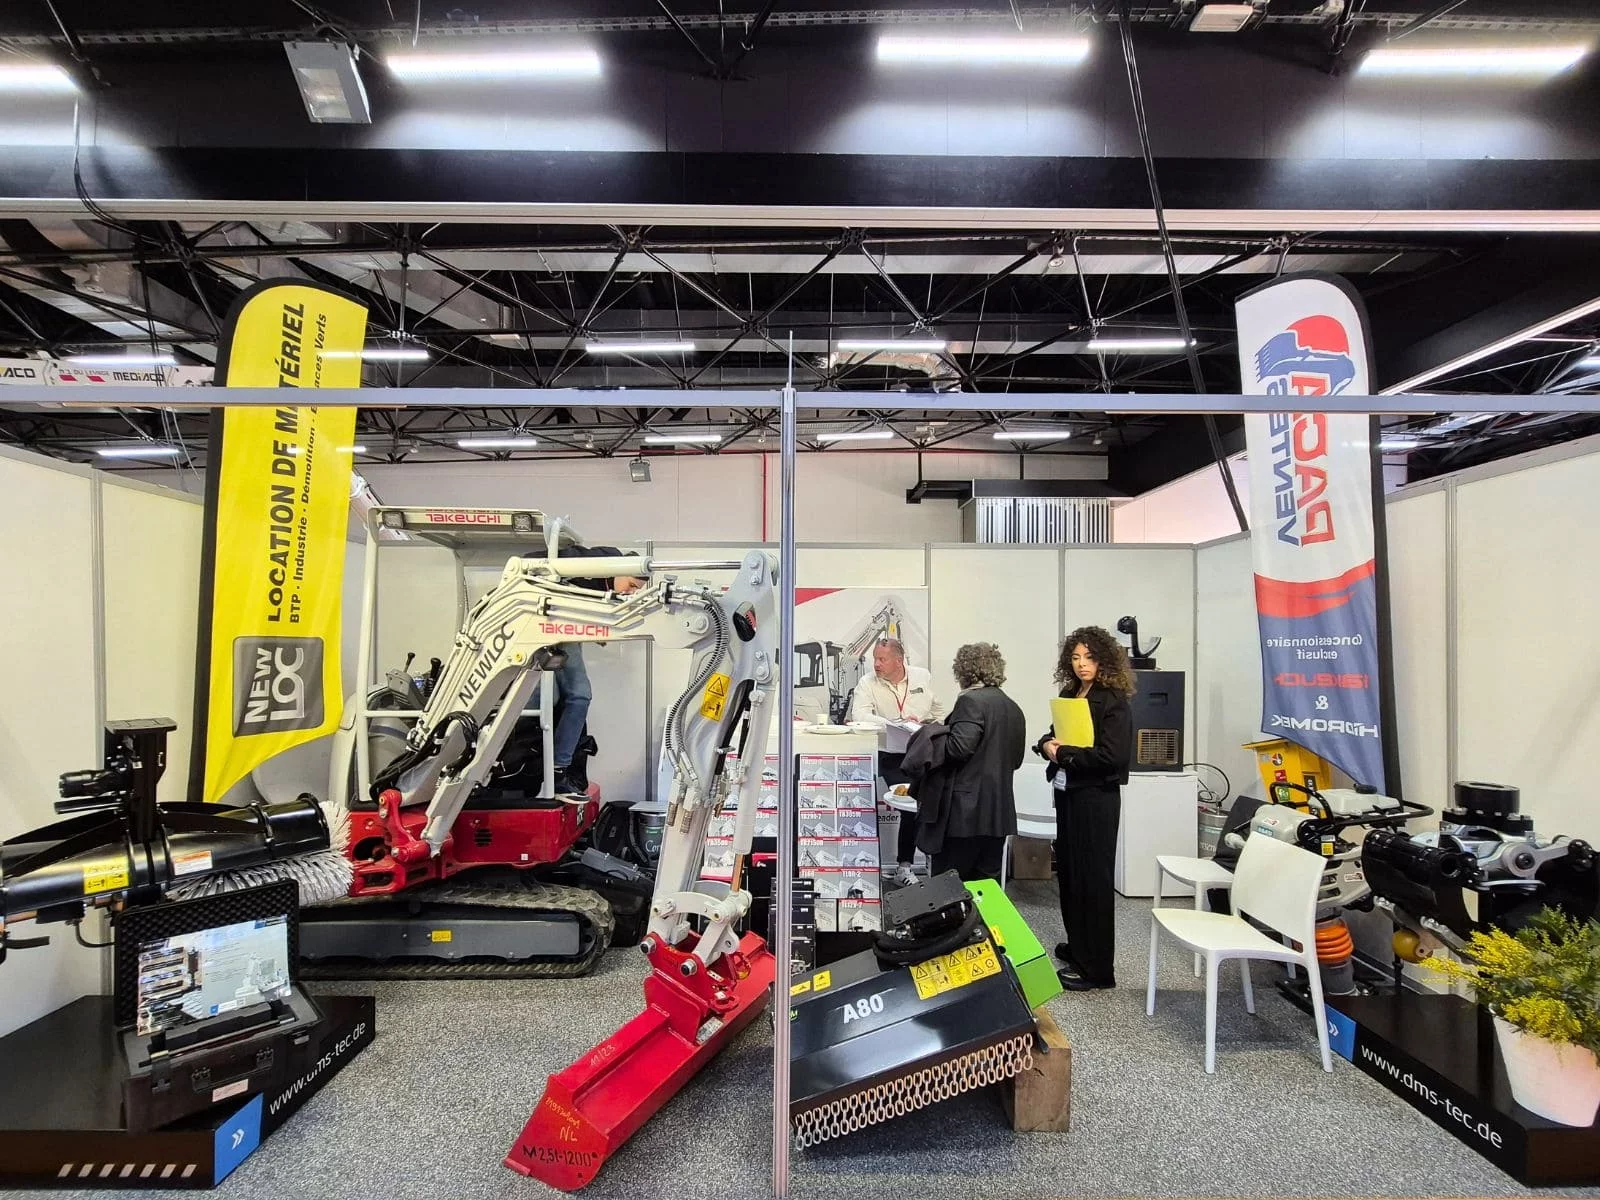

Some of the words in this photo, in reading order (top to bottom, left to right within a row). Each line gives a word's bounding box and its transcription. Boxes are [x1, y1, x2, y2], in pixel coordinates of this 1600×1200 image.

[315, 313, 327, 350] Verts
[1, 367, 36, 379] ACO
[274, 303, 305, 434] MTÉRIEL
[272, 440, 297, 477] DE
[302, 427, 316, 504] Démolition
[268, 485, 295, 622] LOCATION
[293, 517, 308, 581] Industrie
[290, 594, 302, 623] BTP
[244, 647, 272, 723] NEW
[270, 647, 305, 721] LOC
[877, 813, 899, 822] eader
[843, 994, 884, 1025] A80
[1361, 1045, 1503, 1149] www.dms-tec.de
